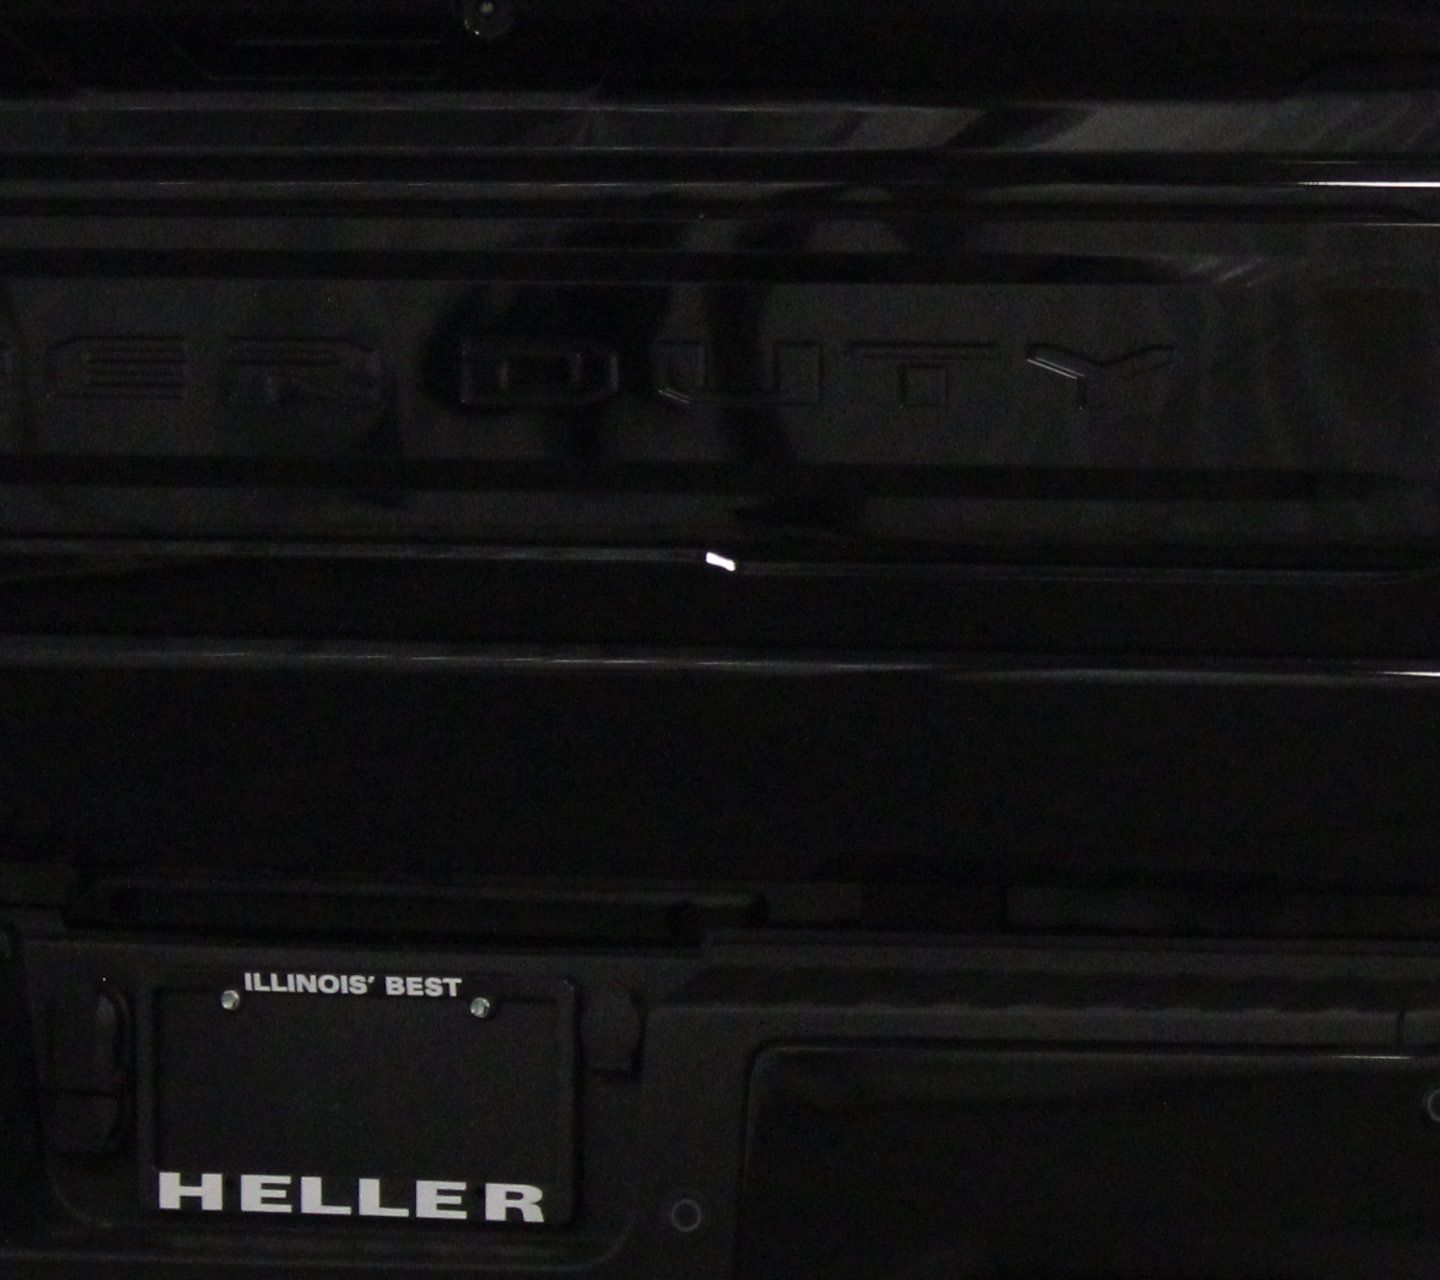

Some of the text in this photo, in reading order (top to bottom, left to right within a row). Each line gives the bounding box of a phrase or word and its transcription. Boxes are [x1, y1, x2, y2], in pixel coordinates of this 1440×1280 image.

[244, 972, 463, 998] ILLINOIS' BEST
[158, 1171, 546, 1223] HELLER
